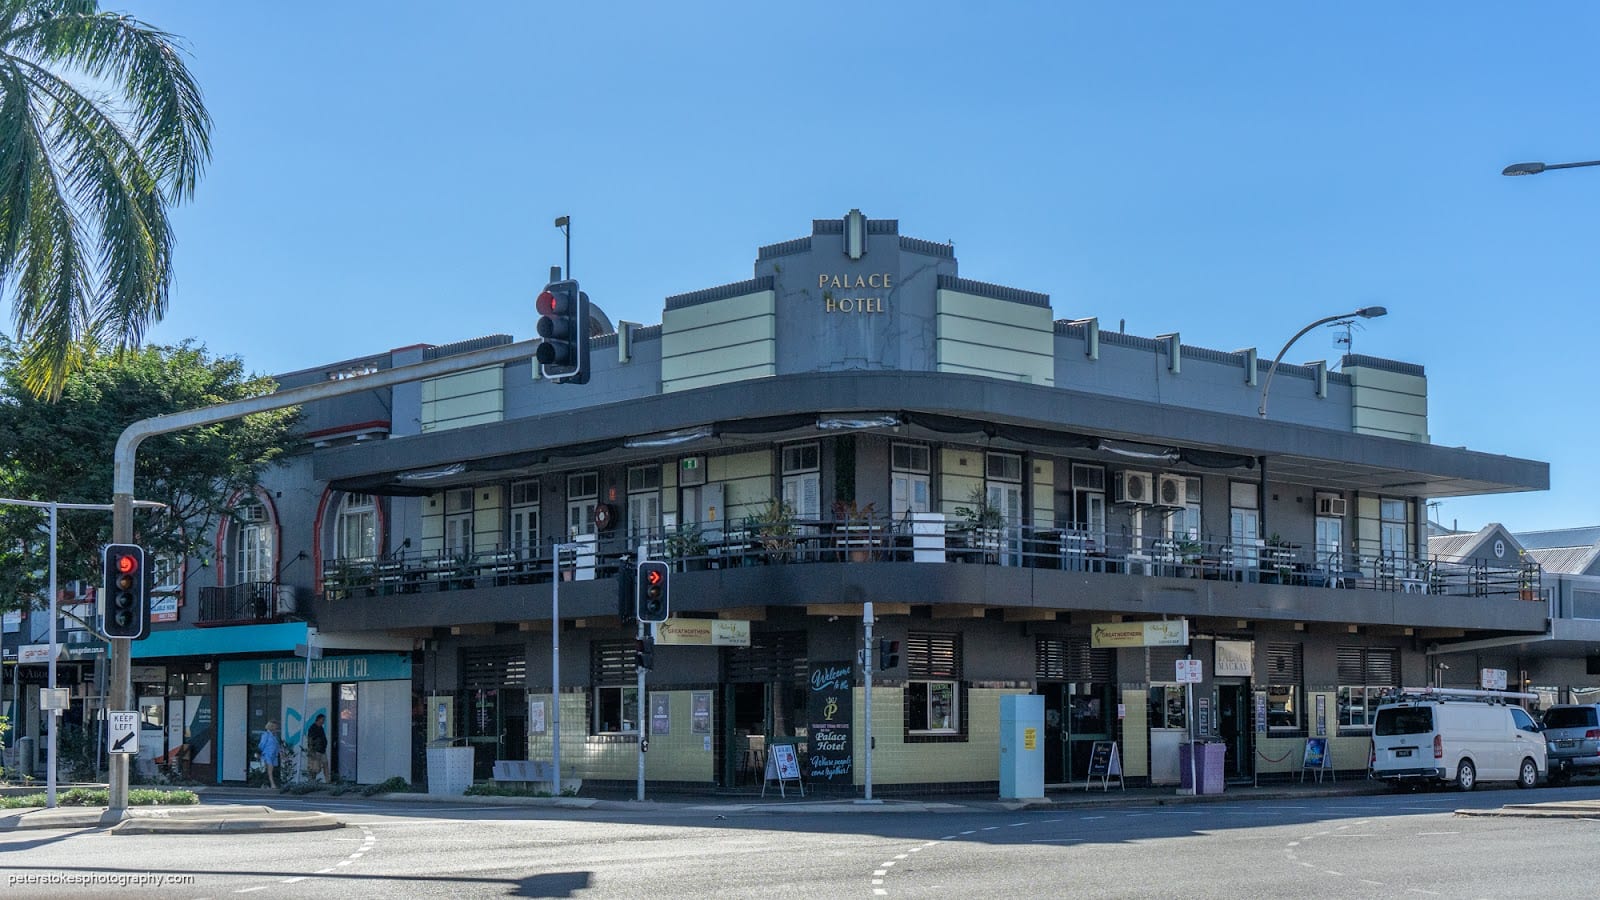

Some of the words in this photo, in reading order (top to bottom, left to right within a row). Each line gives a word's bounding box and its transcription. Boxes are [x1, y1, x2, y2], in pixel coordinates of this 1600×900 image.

[819, 273, 892, 288] PALACE
[826, 298, 885, 313] HOTEL
[3, 668, 25, 678] MN
[260, 663, 275, 681] THE
[277, 661, 306, 680] COFFIN
[310, 659, 350, 679] CREATIVE
[353, 658, 370, 677] CO.
[811, 666, 851, 687] Welcome
[823, 703, 838, 721] P
[114, 723, 133, 731] LEFT
[816, 731, 847, 741] Palace
[816, 741, 846, 751] Hotel
